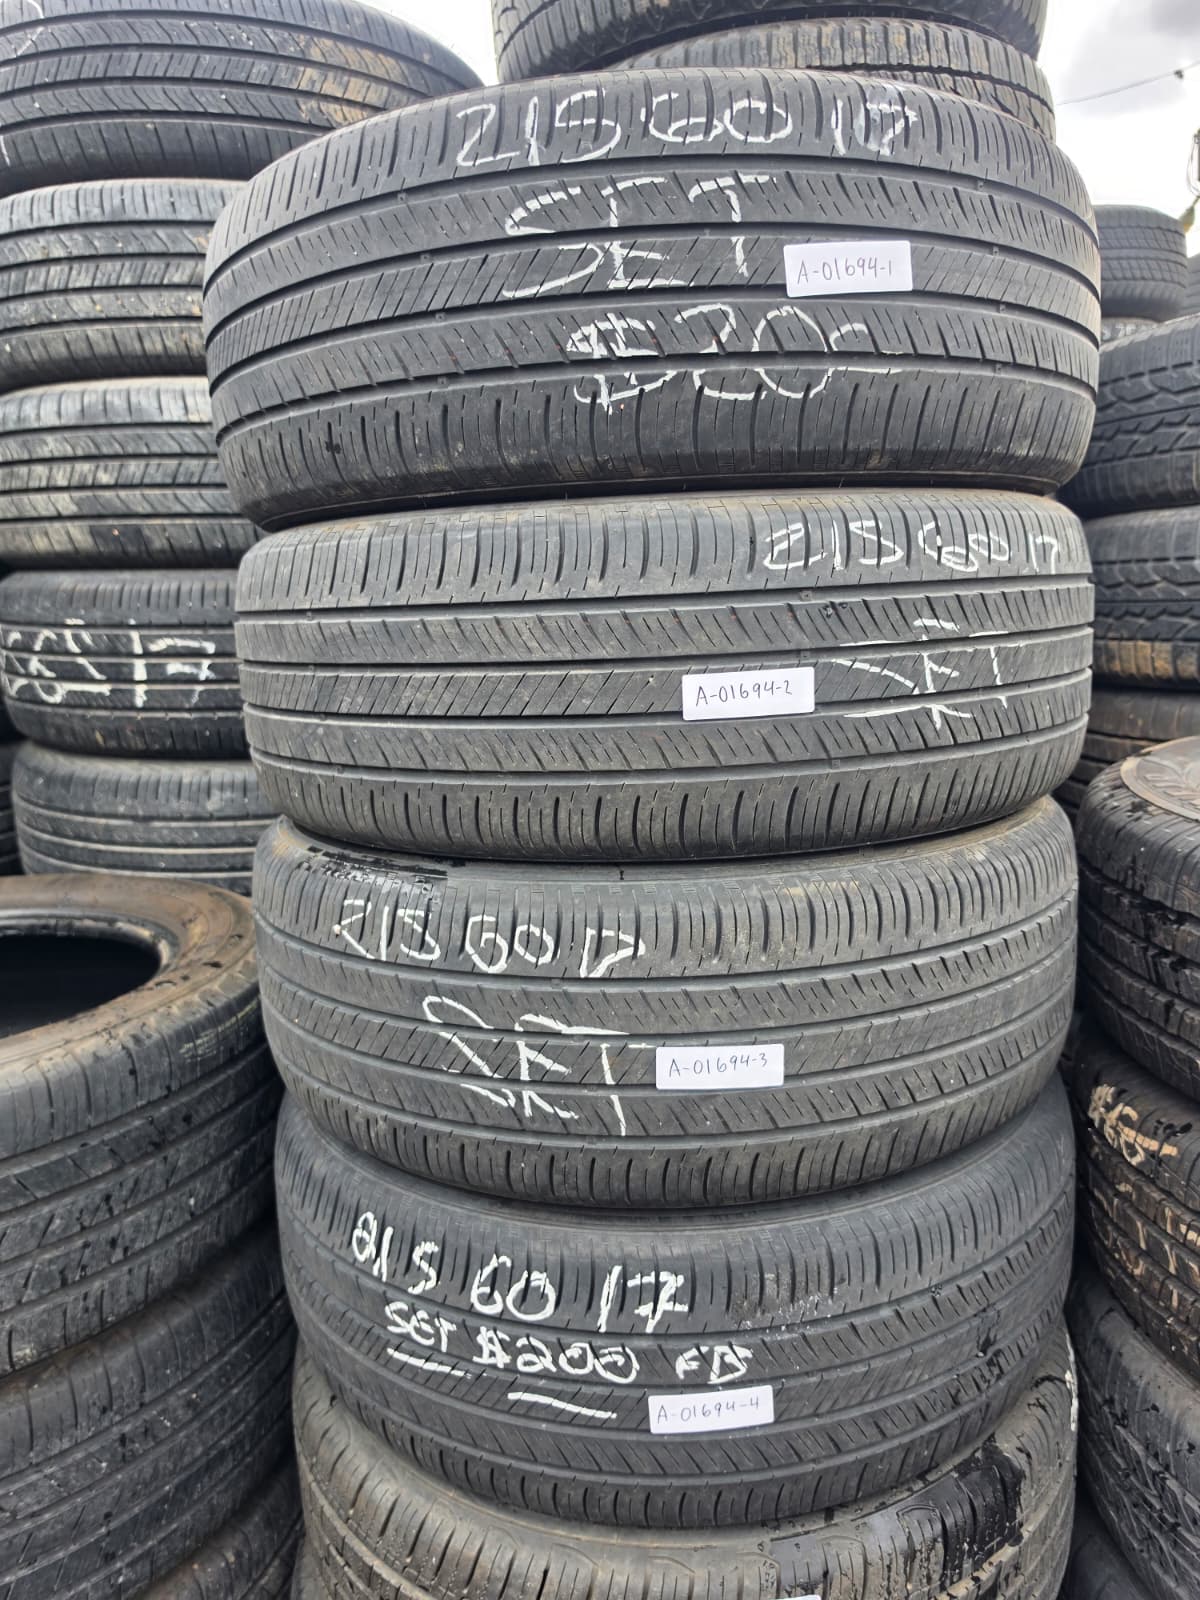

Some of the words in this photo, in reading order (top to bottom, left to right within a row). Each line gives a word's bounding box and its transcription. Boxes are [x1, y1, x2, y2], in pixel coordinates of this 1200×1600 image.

[456, 90, 622, 167] 215
[640, 92, 793, 144] 60
[797, 259, 893, 284] A-01694-1
[763, 520, 904, 571] 215
[695, 680, 793, 707] A-01694-2
[334, 899, 441, 961] 215
[465, 914, 560, 973] 60
[668, 1051, 769, 1077] A-01694-3
[351, 1211, 438, 1295] 215
[471, 1255, 556, 1321] 60
[597, 1265, 689, 1333] 17
[385, 1301, 457, 1352] SET
[473, 1326, 641, 1384] $200
[656, 1396, 762, 1426] A-01694-4
